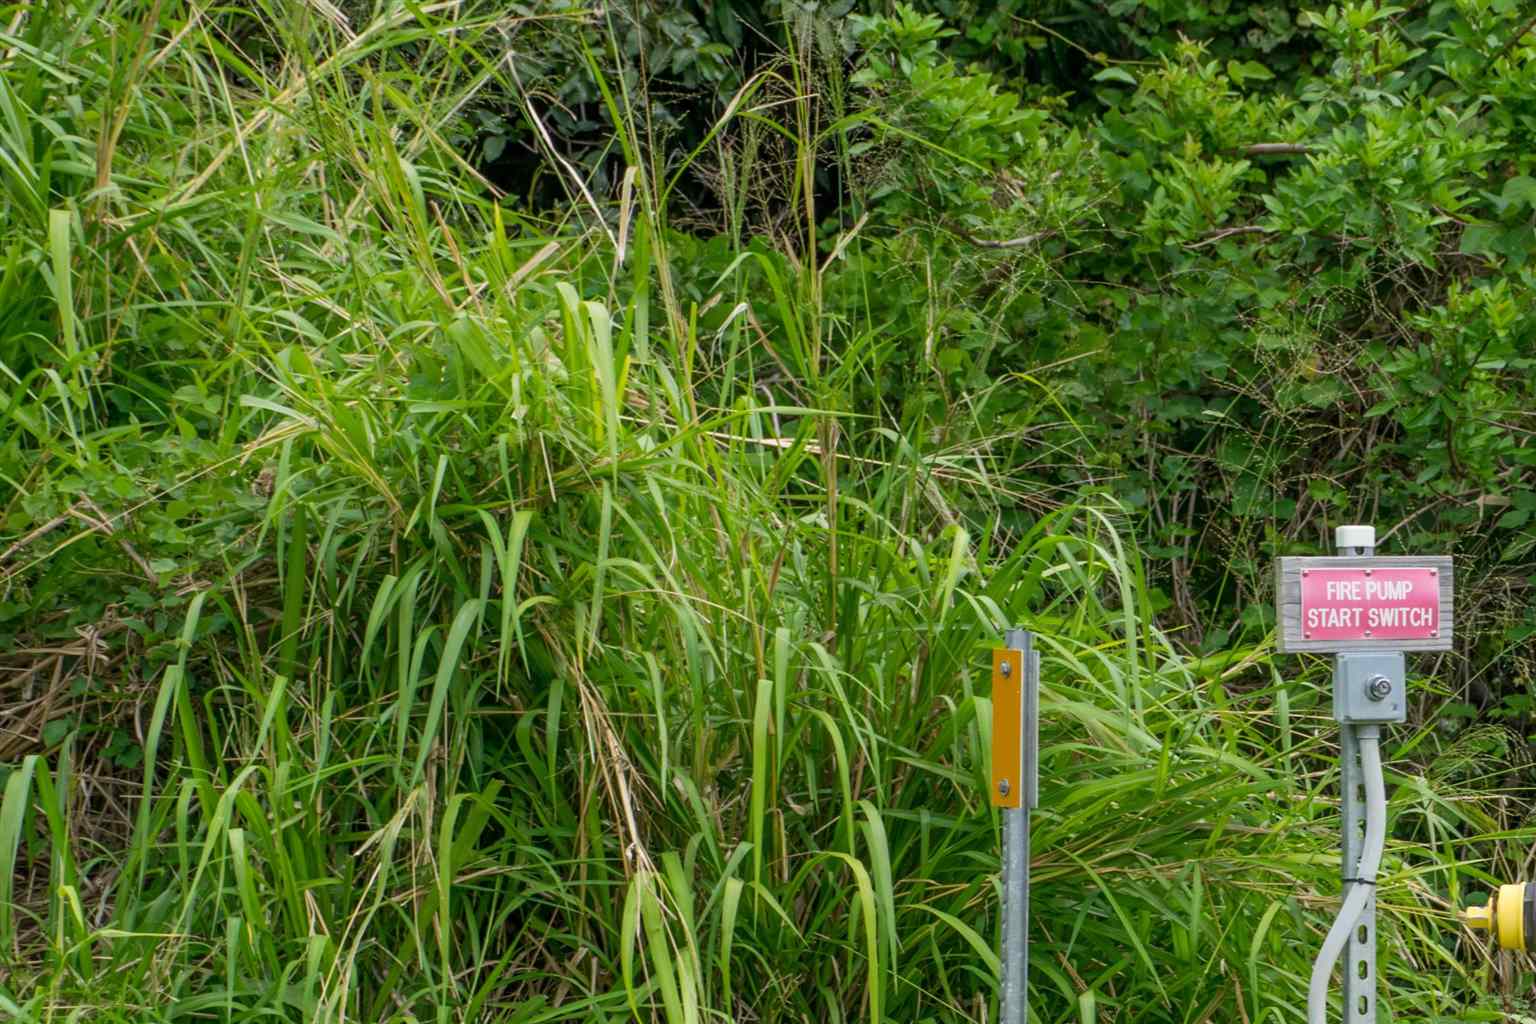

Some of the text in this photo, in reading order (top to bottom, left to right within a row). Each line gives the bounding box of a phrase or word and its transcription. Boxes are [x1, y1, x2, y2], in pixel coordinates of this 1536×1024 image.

[1326, 580, 1413, 601] FIRE PUMP
[1307, 607, 1433, 628] START SWITCH
